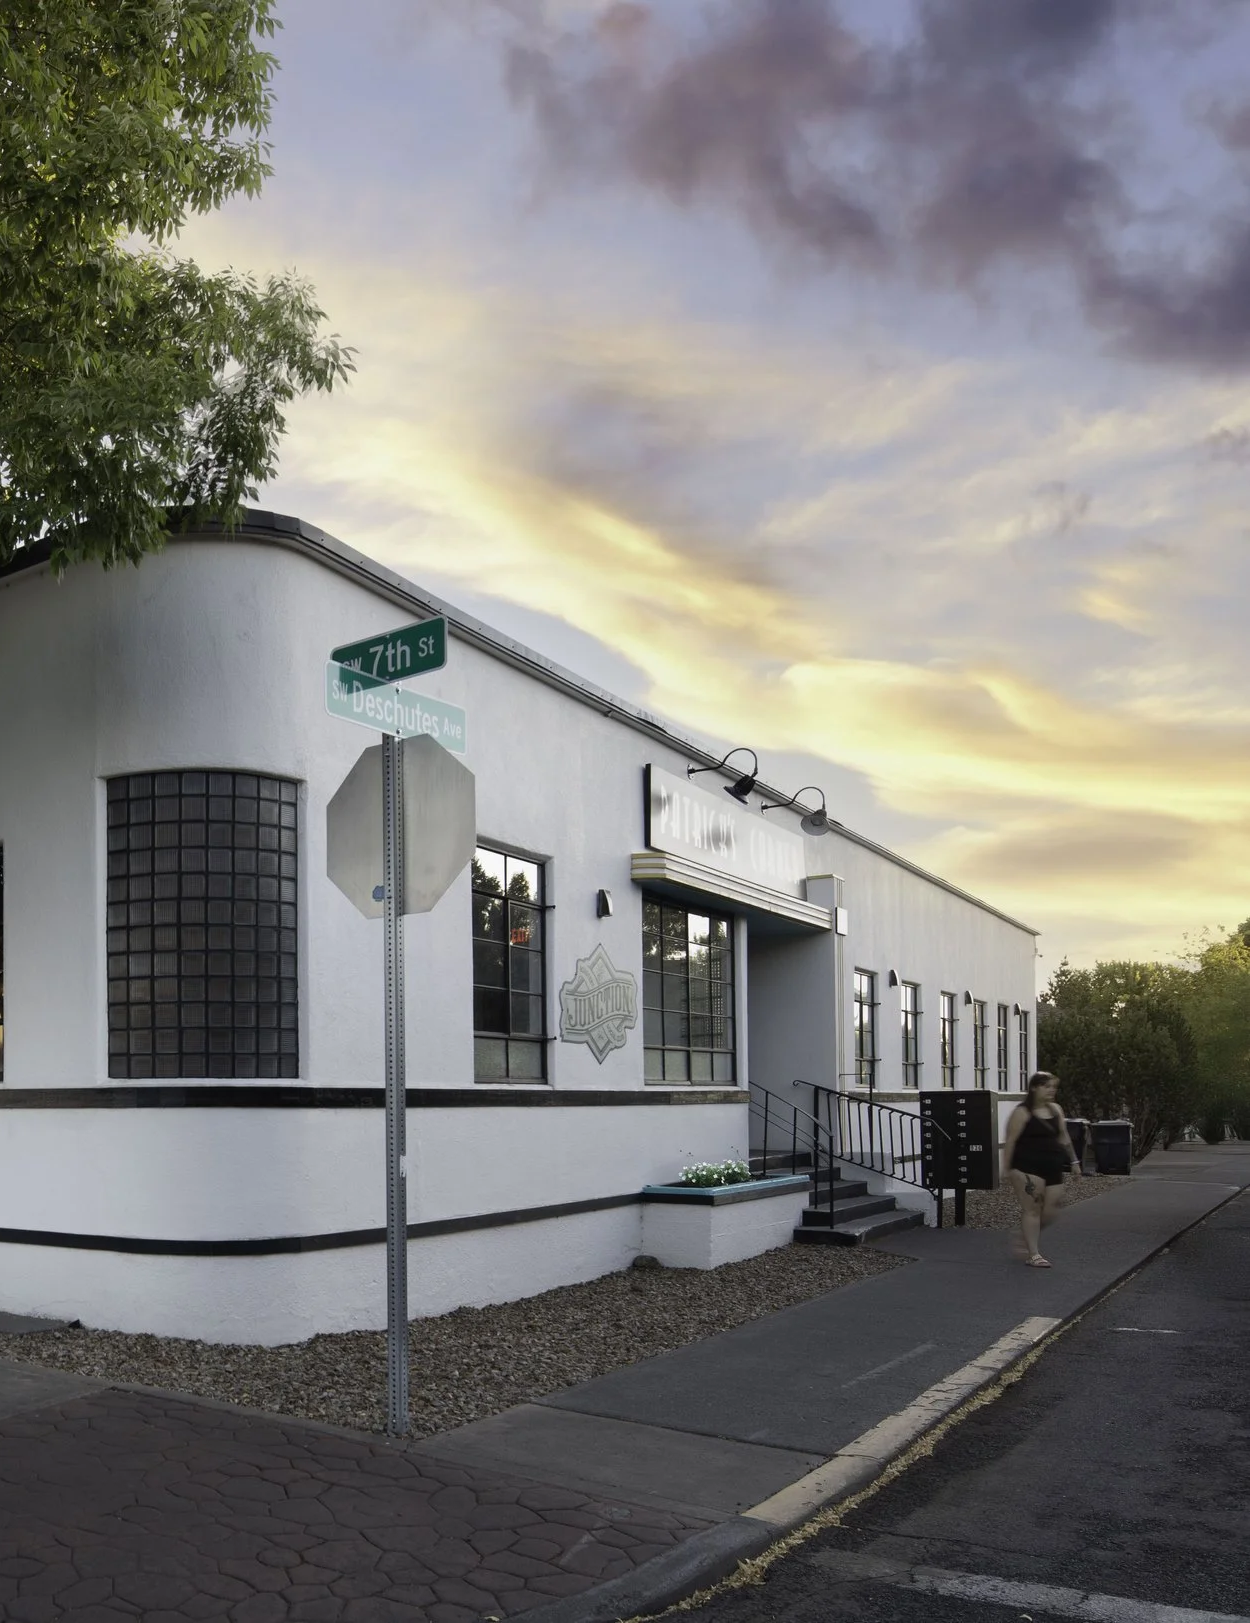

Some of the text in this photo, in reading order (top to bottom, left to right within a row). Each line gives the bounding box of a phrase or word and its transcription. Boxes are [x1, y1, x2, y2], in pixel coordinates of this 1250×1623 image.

[369, 638, 411, 678] 7th
[418, 635, 435, 658] St
[332, 679, 462, 740] SW Deschutes Ave
[567, 984, 632, 1028] JUNCTION
